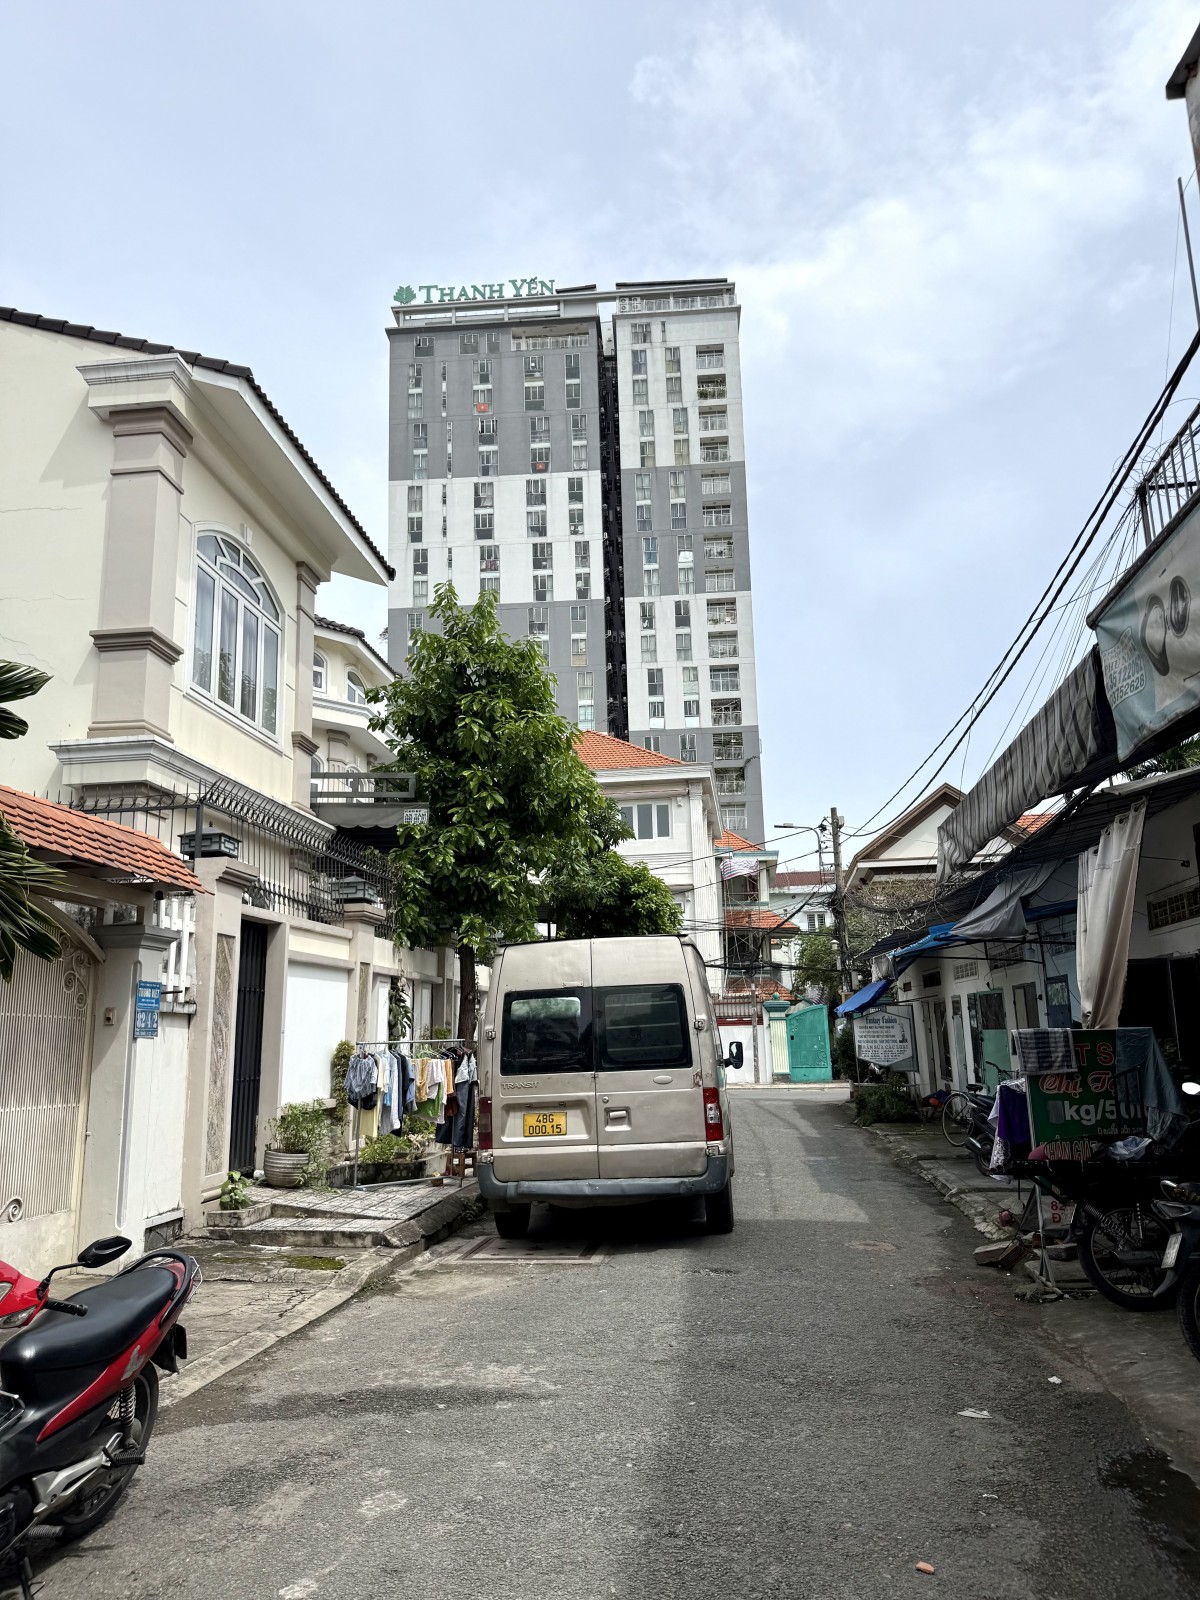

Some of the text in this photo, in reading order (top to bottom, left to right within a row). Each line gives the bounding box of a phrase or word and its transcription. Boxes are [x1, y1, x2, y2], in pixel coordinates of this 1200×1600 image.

[418, 276, 556, 304] THANH YẾN
[502, 1081, 539, 1090] TRANSIT
[536, 1113, 554, 1124] 48G
[528, 1124, 562, 1135] 000.15
